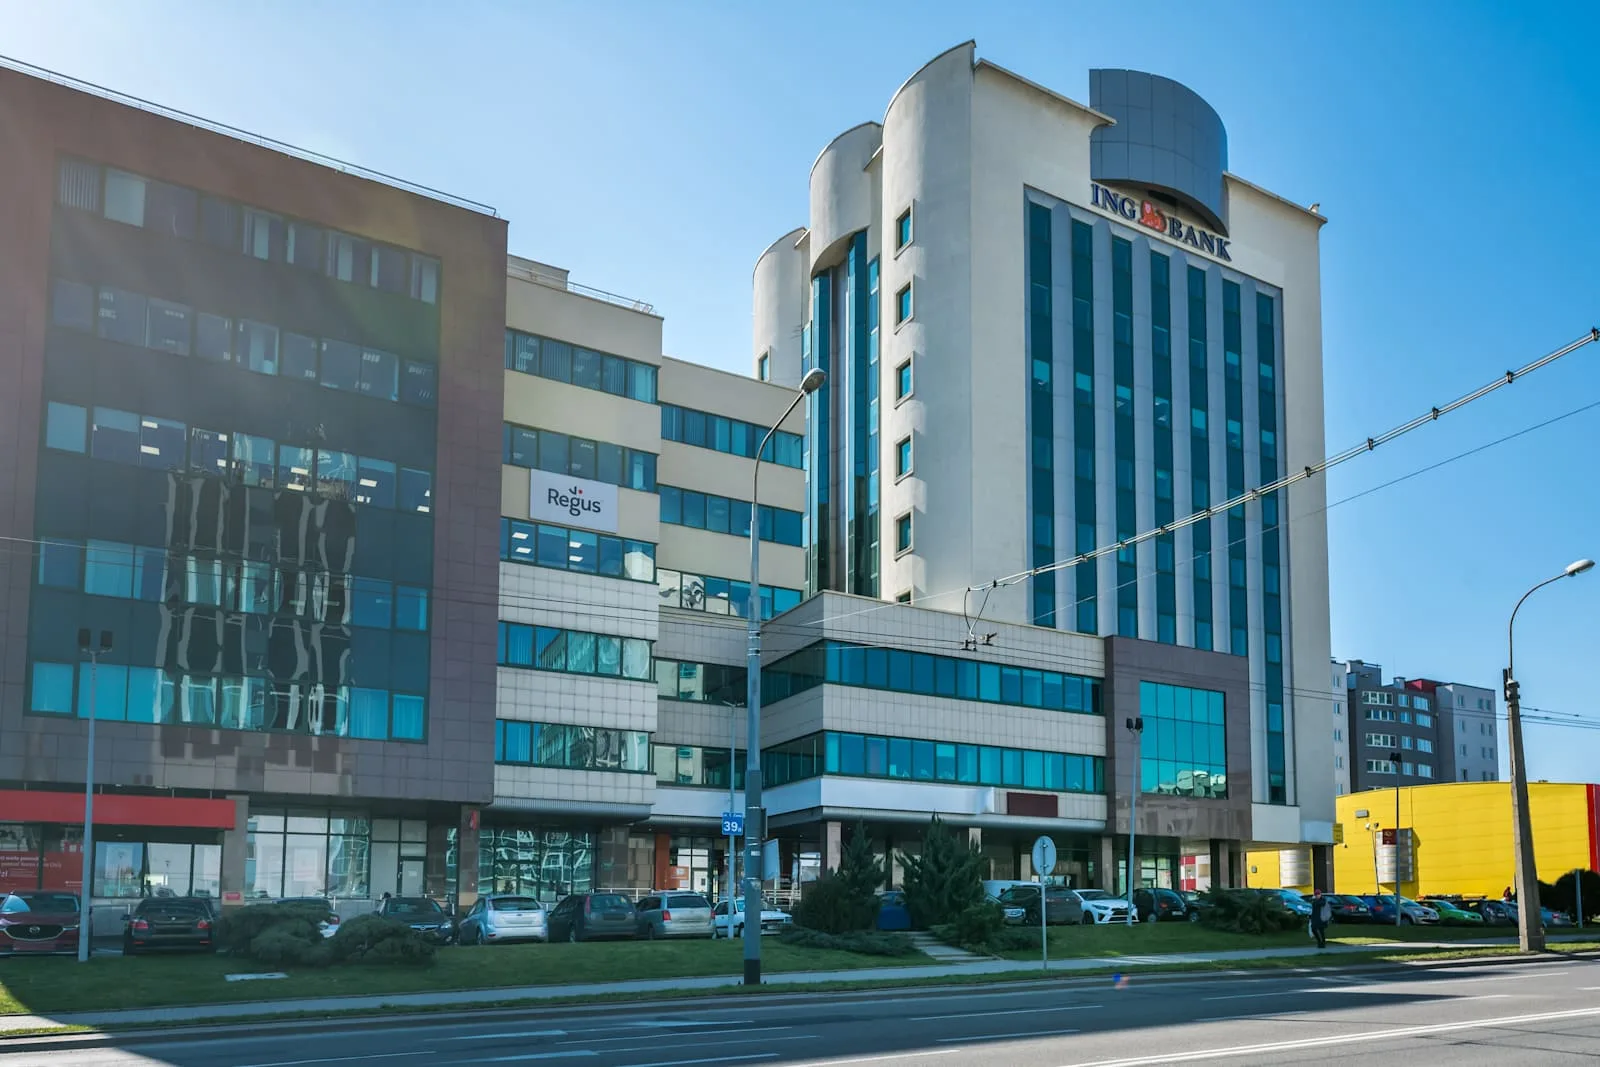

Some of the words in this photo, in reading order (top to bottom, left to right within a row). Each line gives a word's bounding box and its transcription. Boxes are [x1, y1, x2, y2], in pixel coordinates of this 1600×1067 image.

[1091, 183, 1136, 220] ING
[1168, 216, 1232, 262] BANK
[547, 487, 601, 516] Regus
